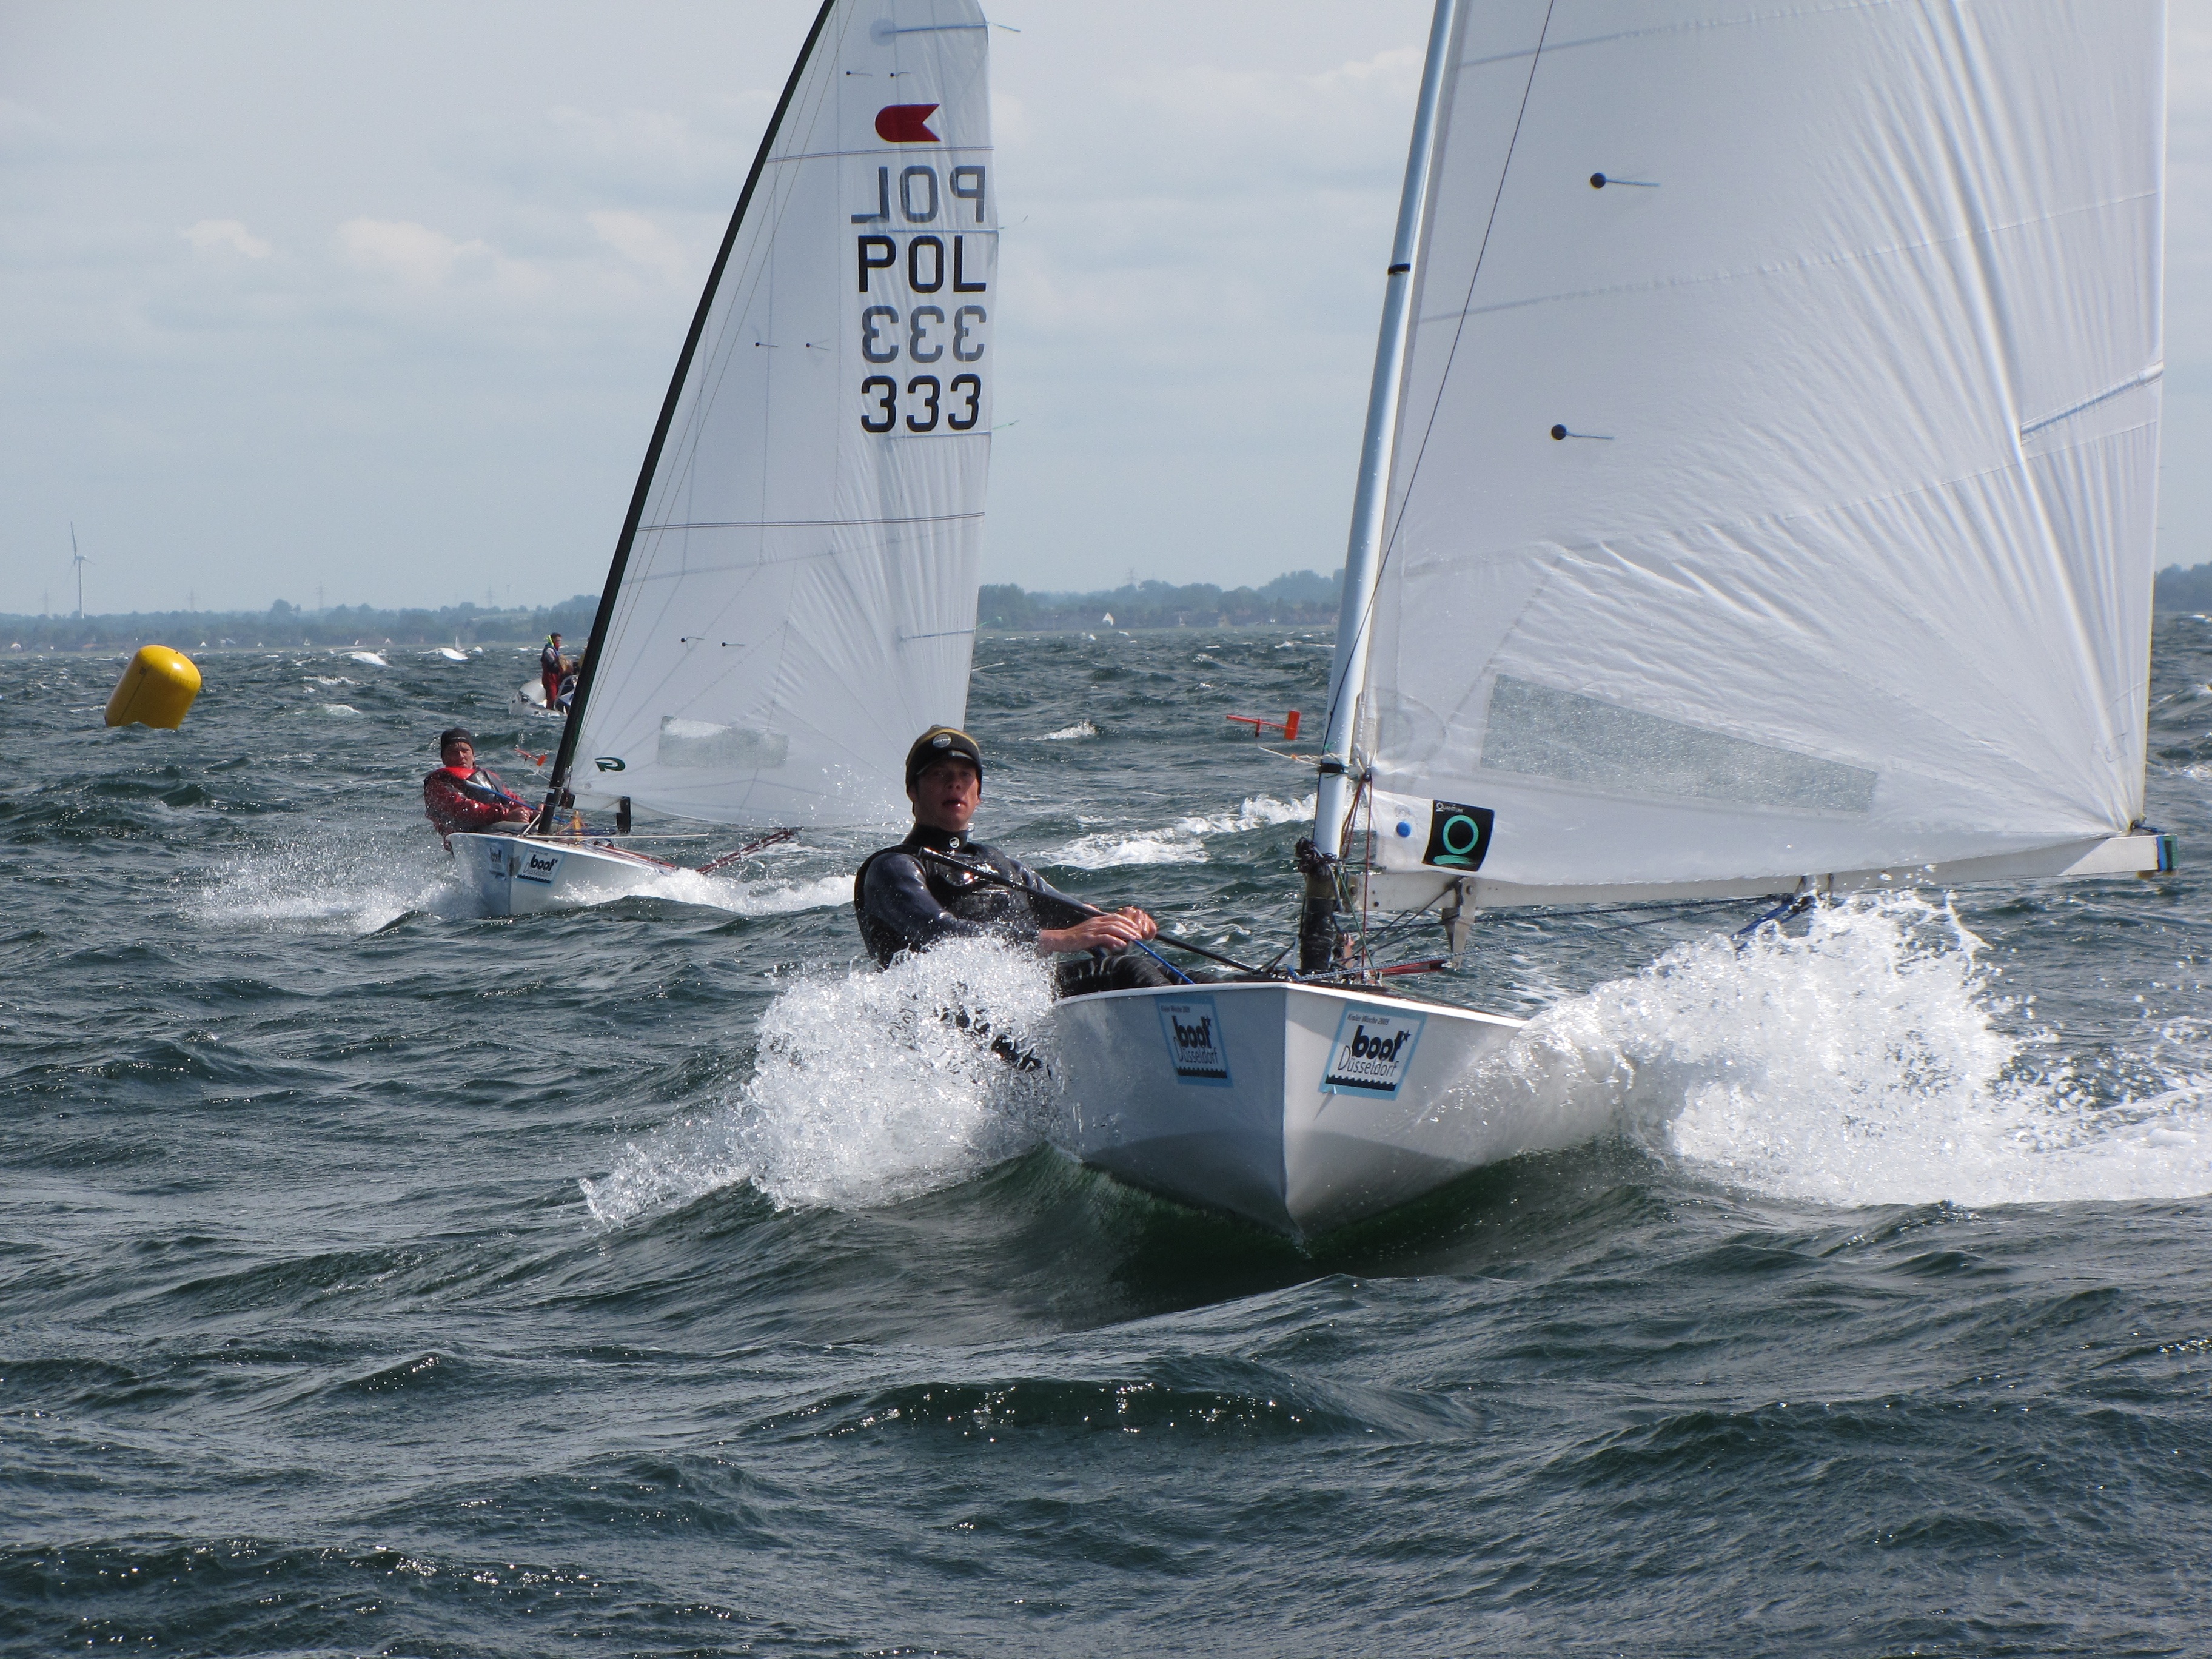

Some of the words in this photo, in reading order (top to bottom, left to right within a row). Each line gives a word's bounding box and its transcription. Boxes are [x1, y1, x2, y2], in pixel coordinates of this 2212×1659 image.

[858, 235, 986, 293] POL
[861, 374, 982, 432] 333
[1171, 1015, 1212, 1048] boot
[1351, 1025, 1404, 1062] boot
[1338, 1045, 1399, 1077] Düsseldorf
